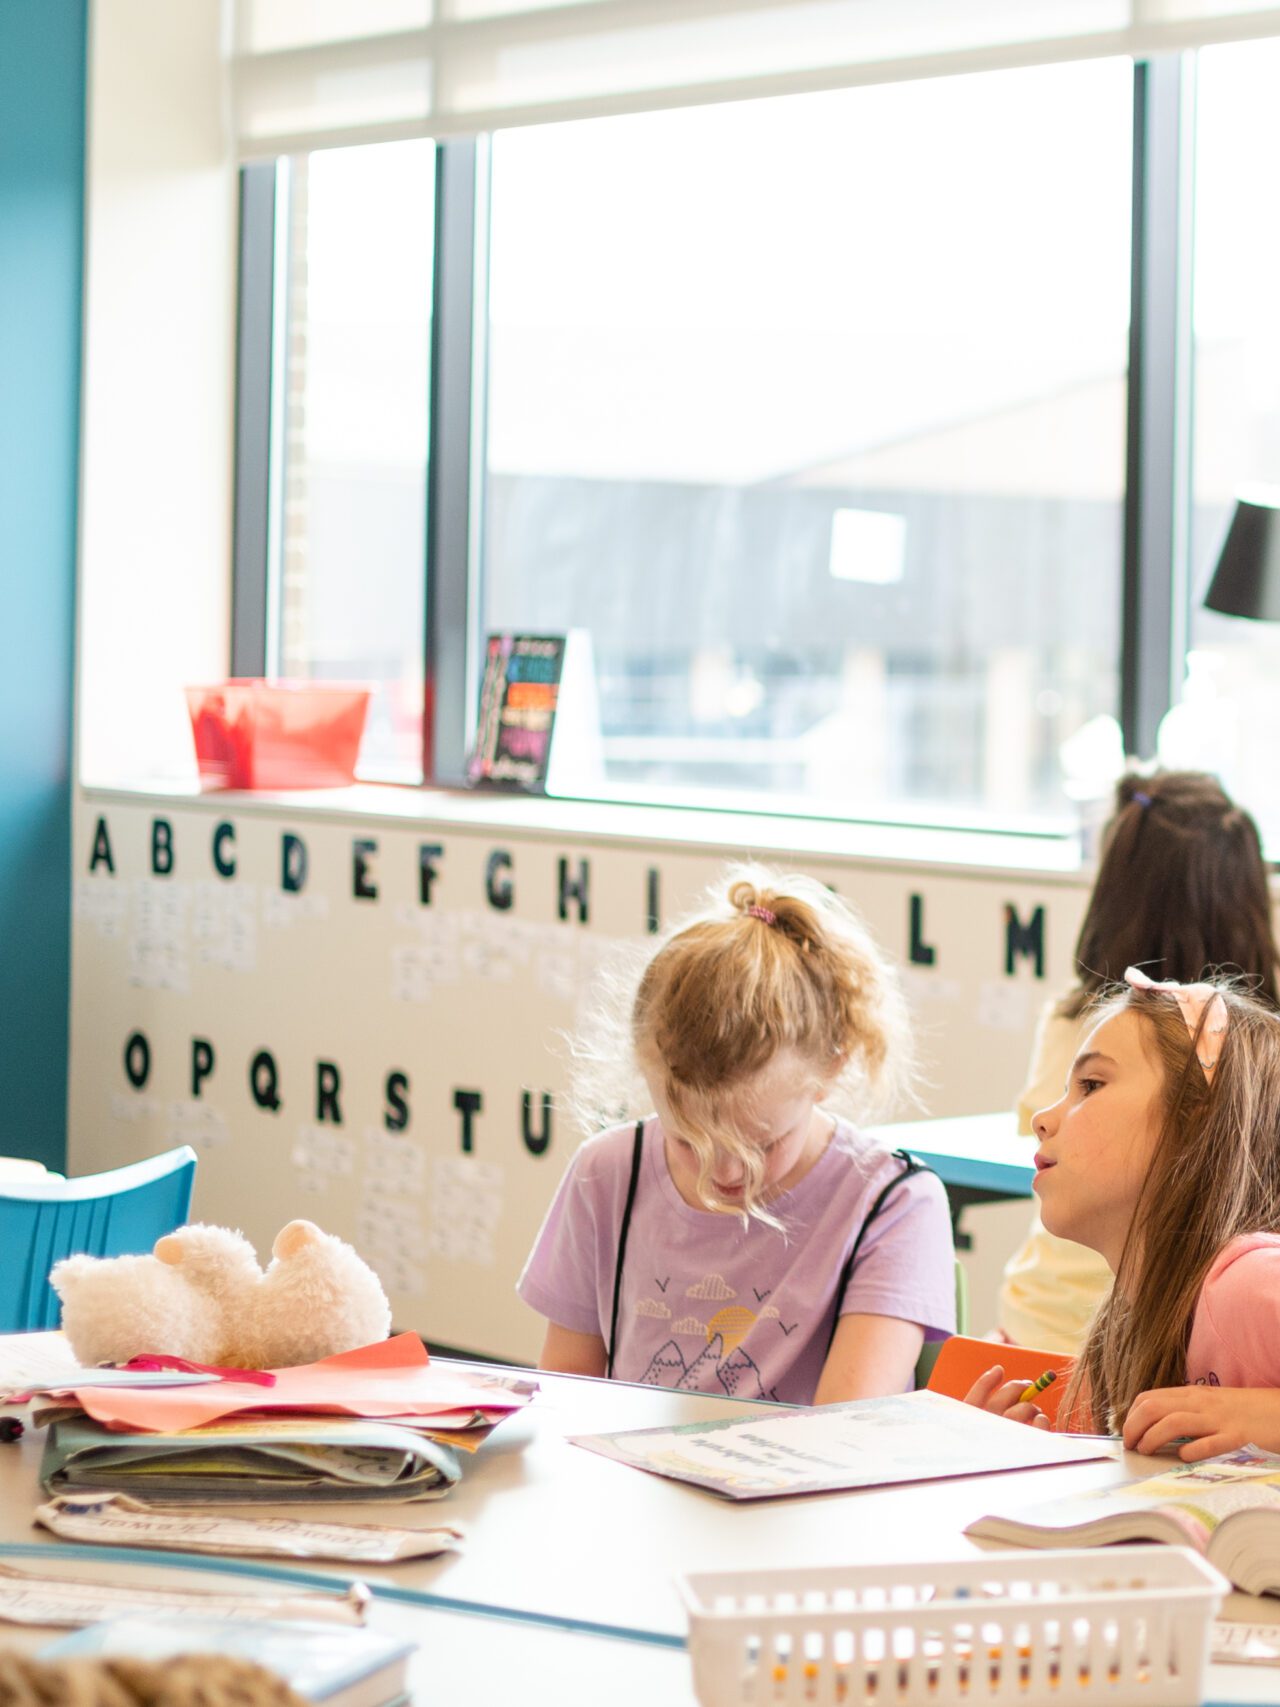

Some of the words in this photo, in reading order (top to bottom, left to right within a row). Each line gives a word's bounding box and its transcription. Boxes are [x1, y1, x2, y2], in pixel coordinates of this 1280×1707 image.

[88, 816, 116, 876] A
[150, 817, 175, 877] B
[211, 820, 237, 879] C
[281, 832, 308, 894] D
[352, 839, 379, 901] E
[418, 844, 443, 906] F
[485, 850, 515, 913] G
[557, 857, 590, 925] H
[646, 868, 660, 934] I
[908, 893, 936, 967] L
[1004, 902, 1046, 980] M
[123, 1030, 152, 1091] O
[191, 1037, 216, 1098] P
[249, 1049, 282, 1113] Q
[316, 1061, 343, 1125] R
[384, 1071, 411, 1132] S
[453, 1088, 484, 1155] T
[521, 1090, 553, 1158] U
